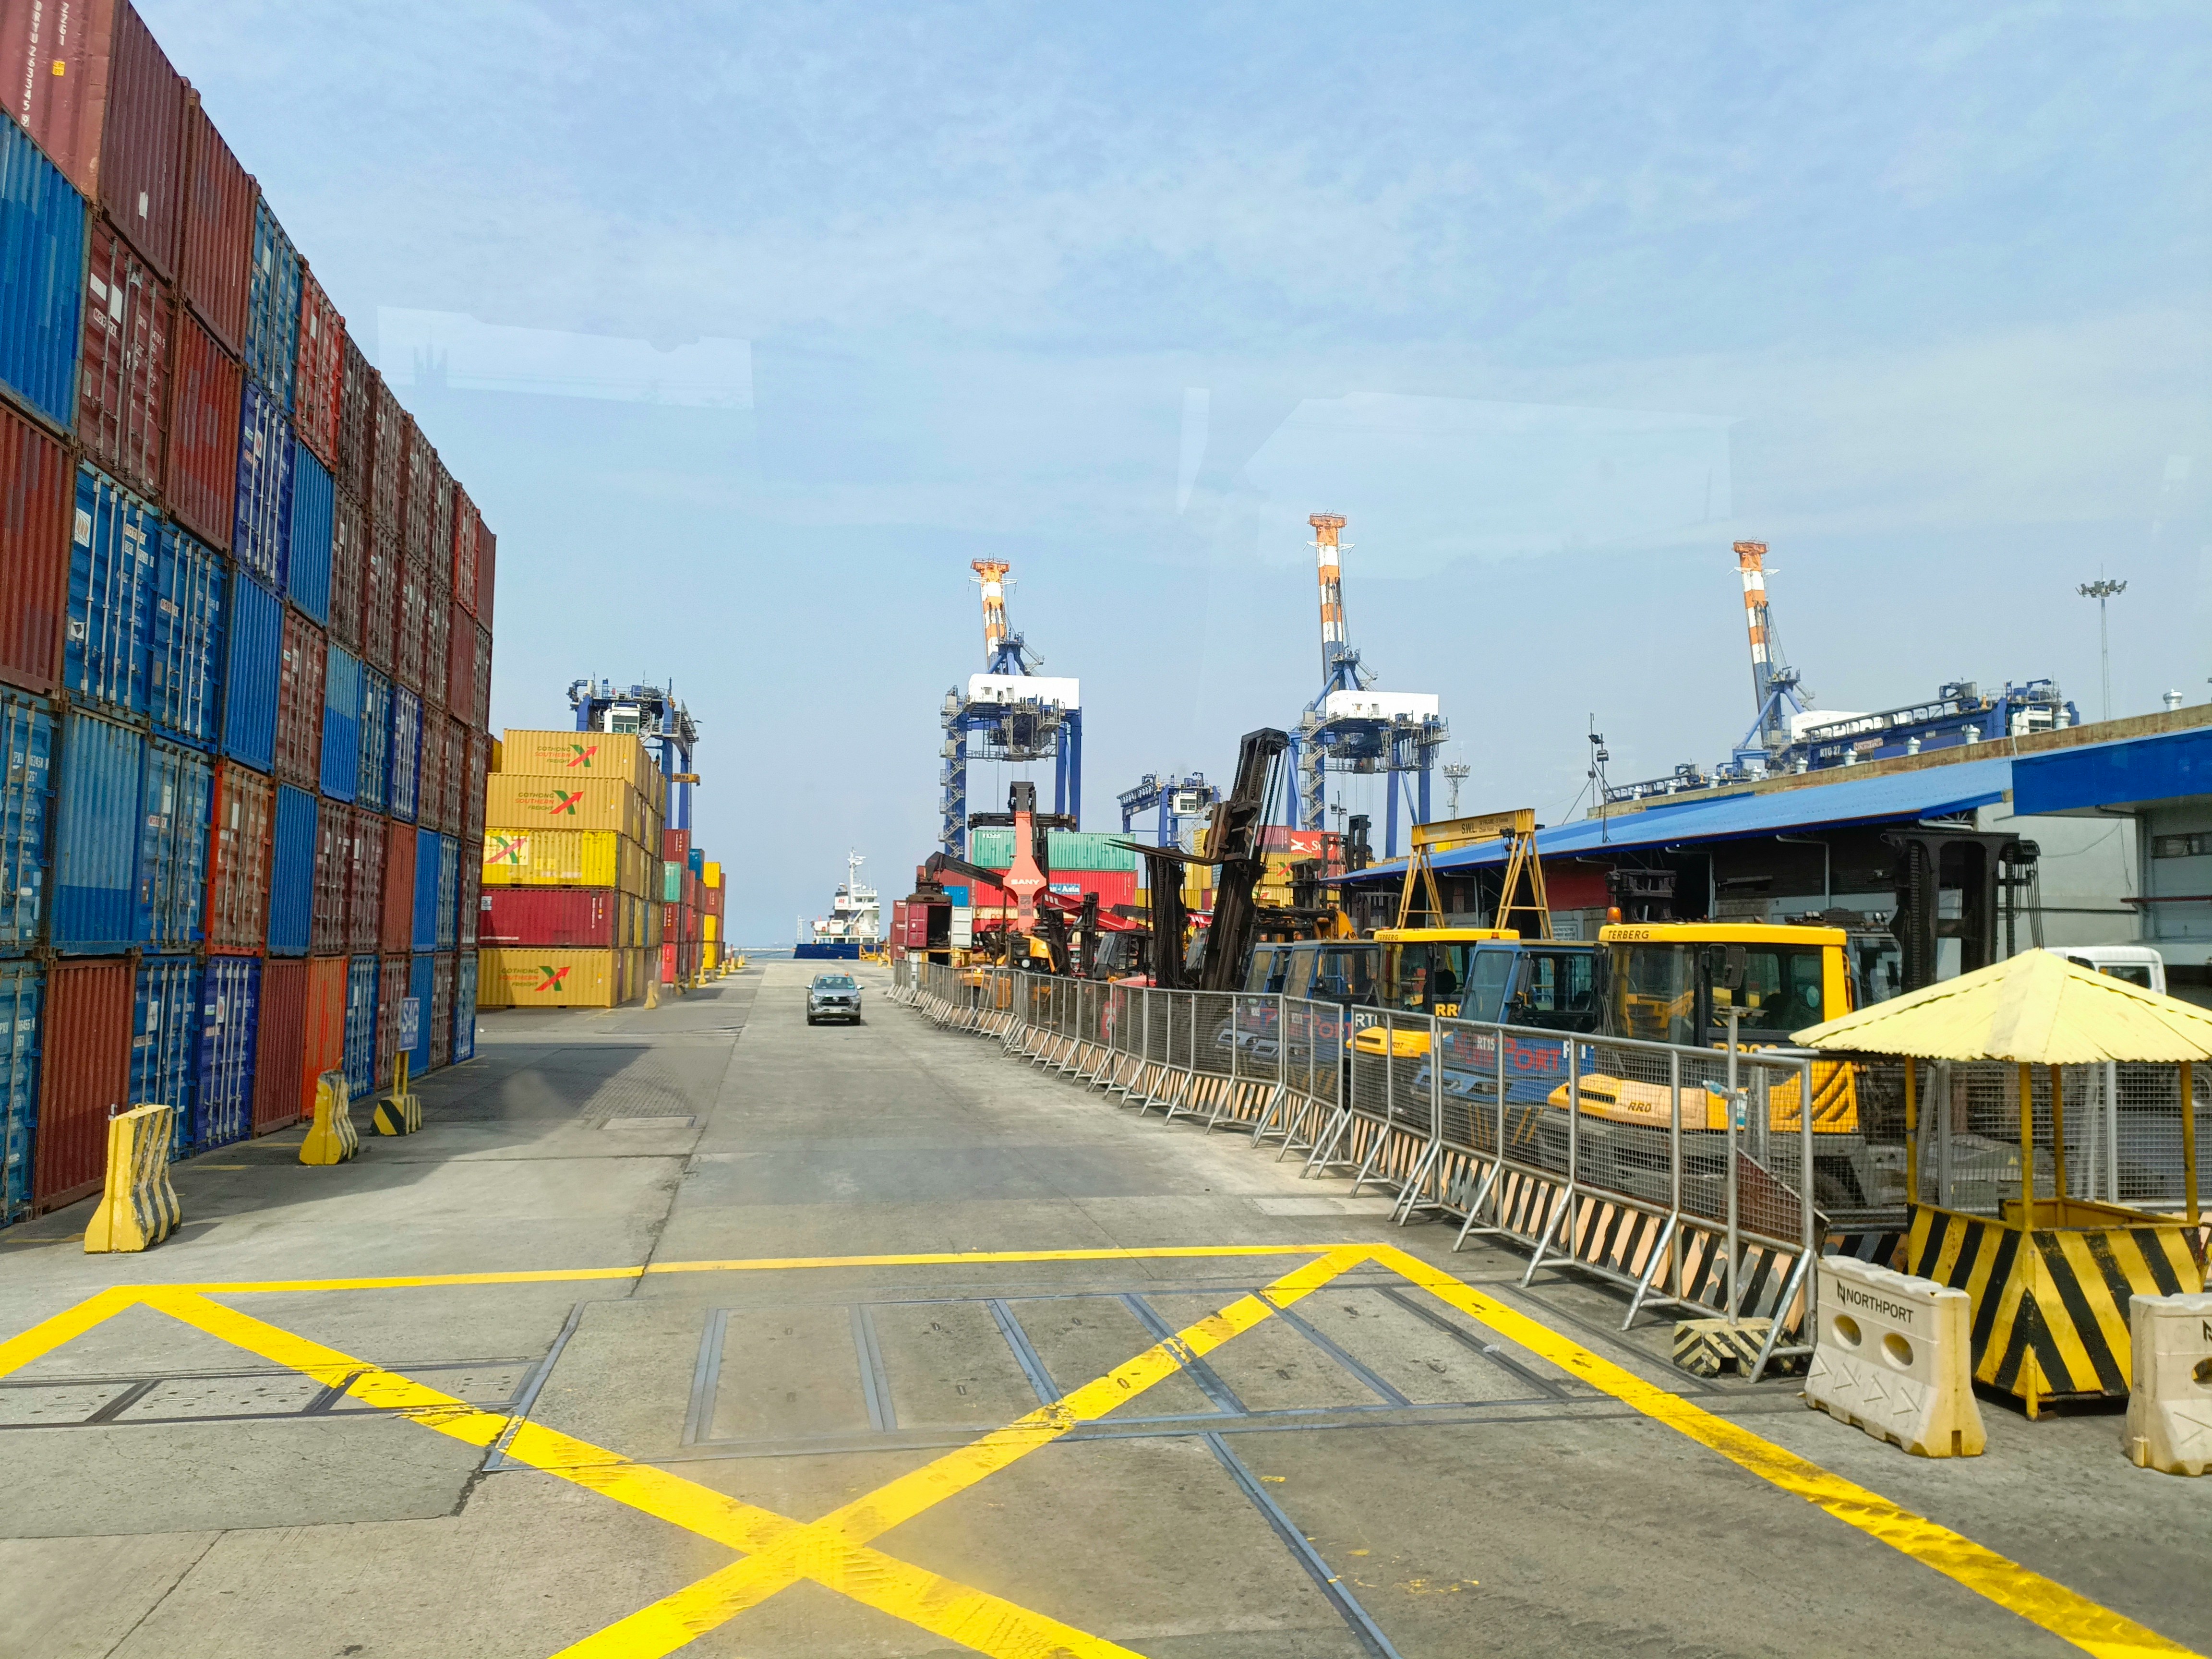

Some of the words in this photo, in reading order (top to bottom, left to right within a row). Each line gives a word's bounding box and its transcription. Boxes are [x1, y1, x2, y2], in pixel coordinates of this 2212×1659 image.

[59, 1, 69, 46] 2261
[23, 45, 36, 111] 263345
[1820, 747, 1832, 757] RTG
[1833, 745, 1841, 756] 27
[1608, 930, 1649, 939] TERBERG
[1846, 1288, 1914, 1323] NORTHPORT
